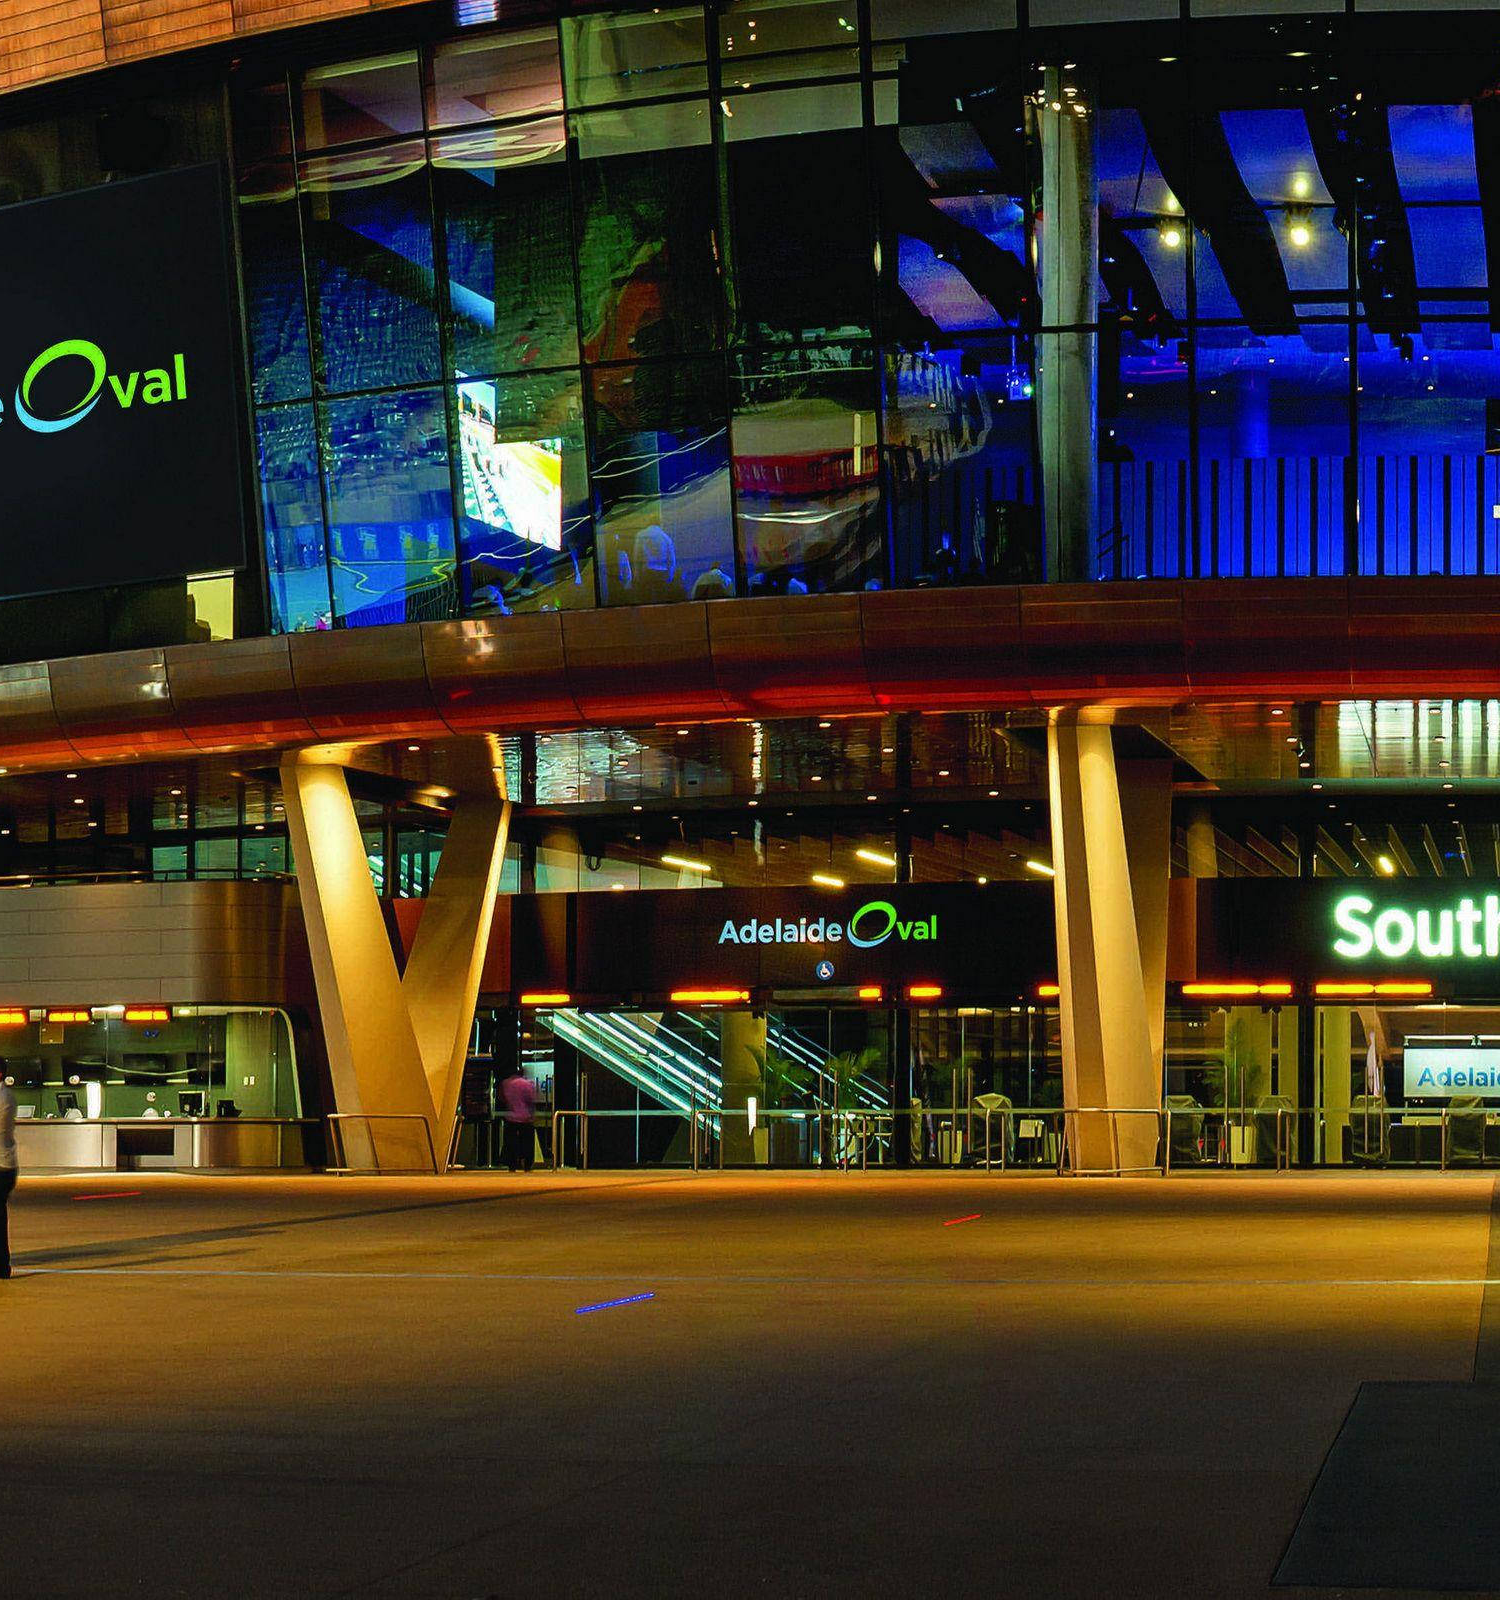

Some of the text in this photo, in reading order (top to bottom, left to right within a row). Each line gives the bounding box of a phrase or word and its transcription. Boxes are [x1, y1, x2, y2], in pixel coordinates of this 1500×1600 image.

[14, 339, 188, 433] Oval
[718, 900, 938, 948] Adelaide Oval
